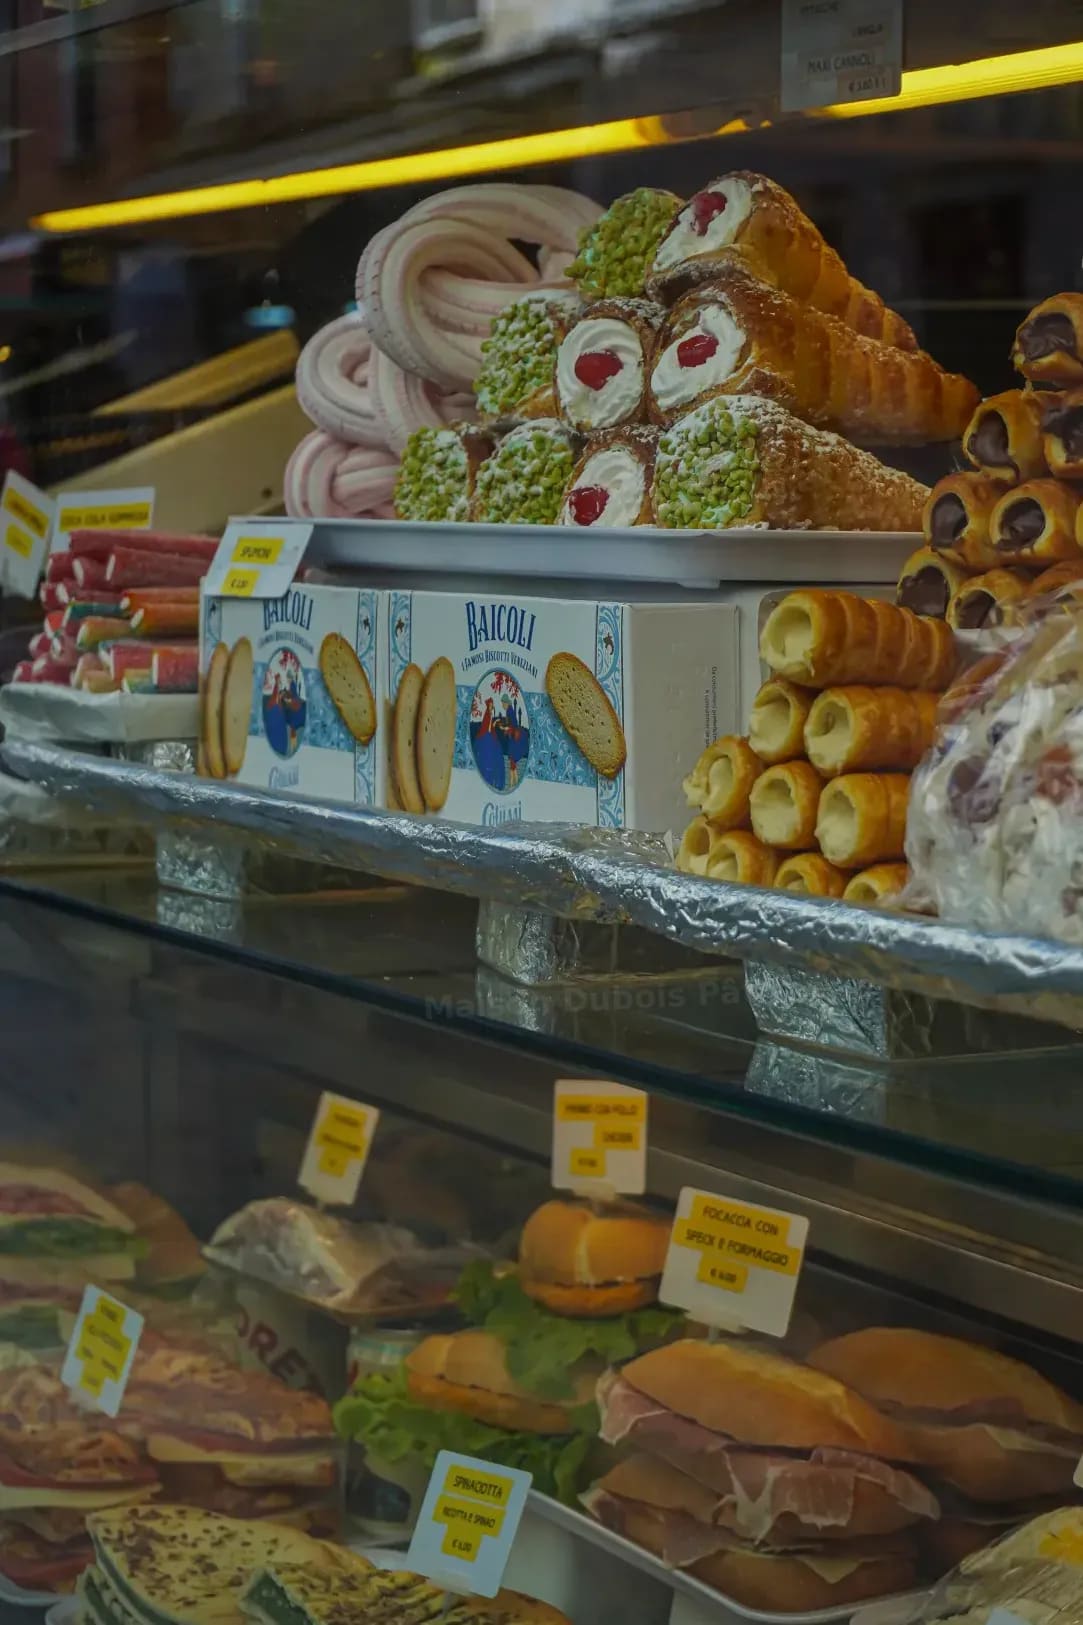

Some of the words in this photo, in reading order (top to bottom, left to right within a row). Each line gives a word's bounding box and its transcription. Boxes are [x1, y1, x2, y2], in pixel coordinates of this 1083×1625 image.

[465, 601, 536, 651] BAICOLI
[485, 650, 510, 664] BISCOTTI
[702, 1205, 751, 1229] FOCACCIA
[755, 1219, 779, 1236] CON
[685, 1228, 715, 1246] SPECK
[727, 1239, 790, 1267] FORMAGGIO
